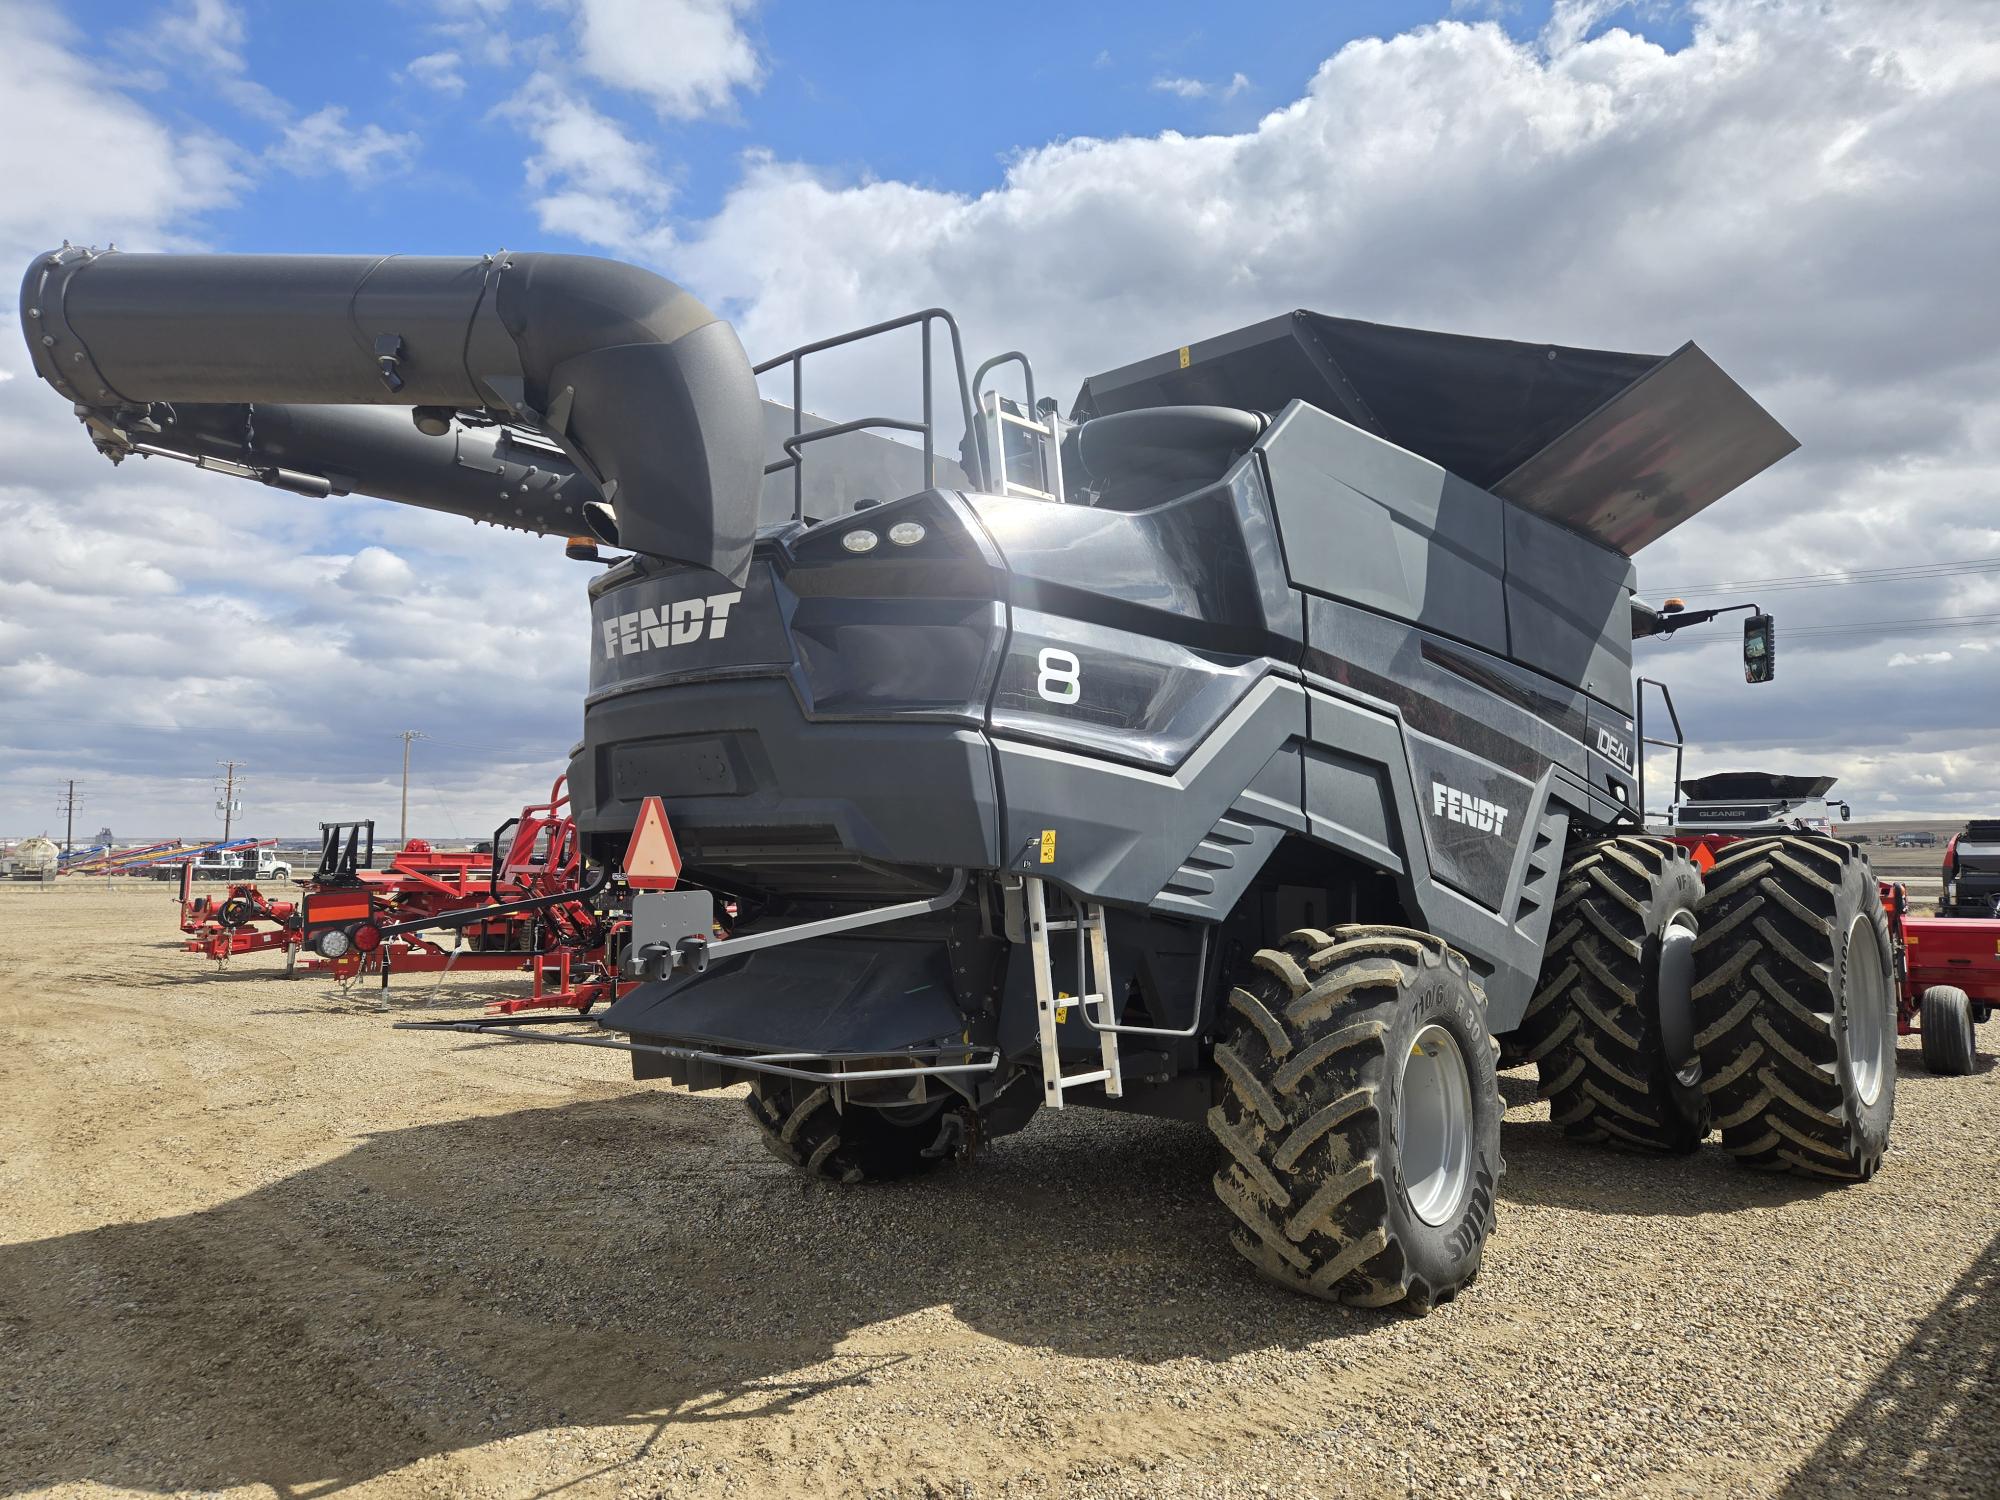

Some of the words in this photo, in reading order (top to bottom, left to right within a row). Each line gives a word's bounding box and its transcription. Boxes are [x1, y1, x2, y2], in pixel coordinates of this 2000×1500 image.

[602, 590, 742, 660] FENDT
[1038, 647, 1080, 704] 8
[1597, 727, 1632, 771] IDEAL
[1432, 781, 1509, 836] FENDT
